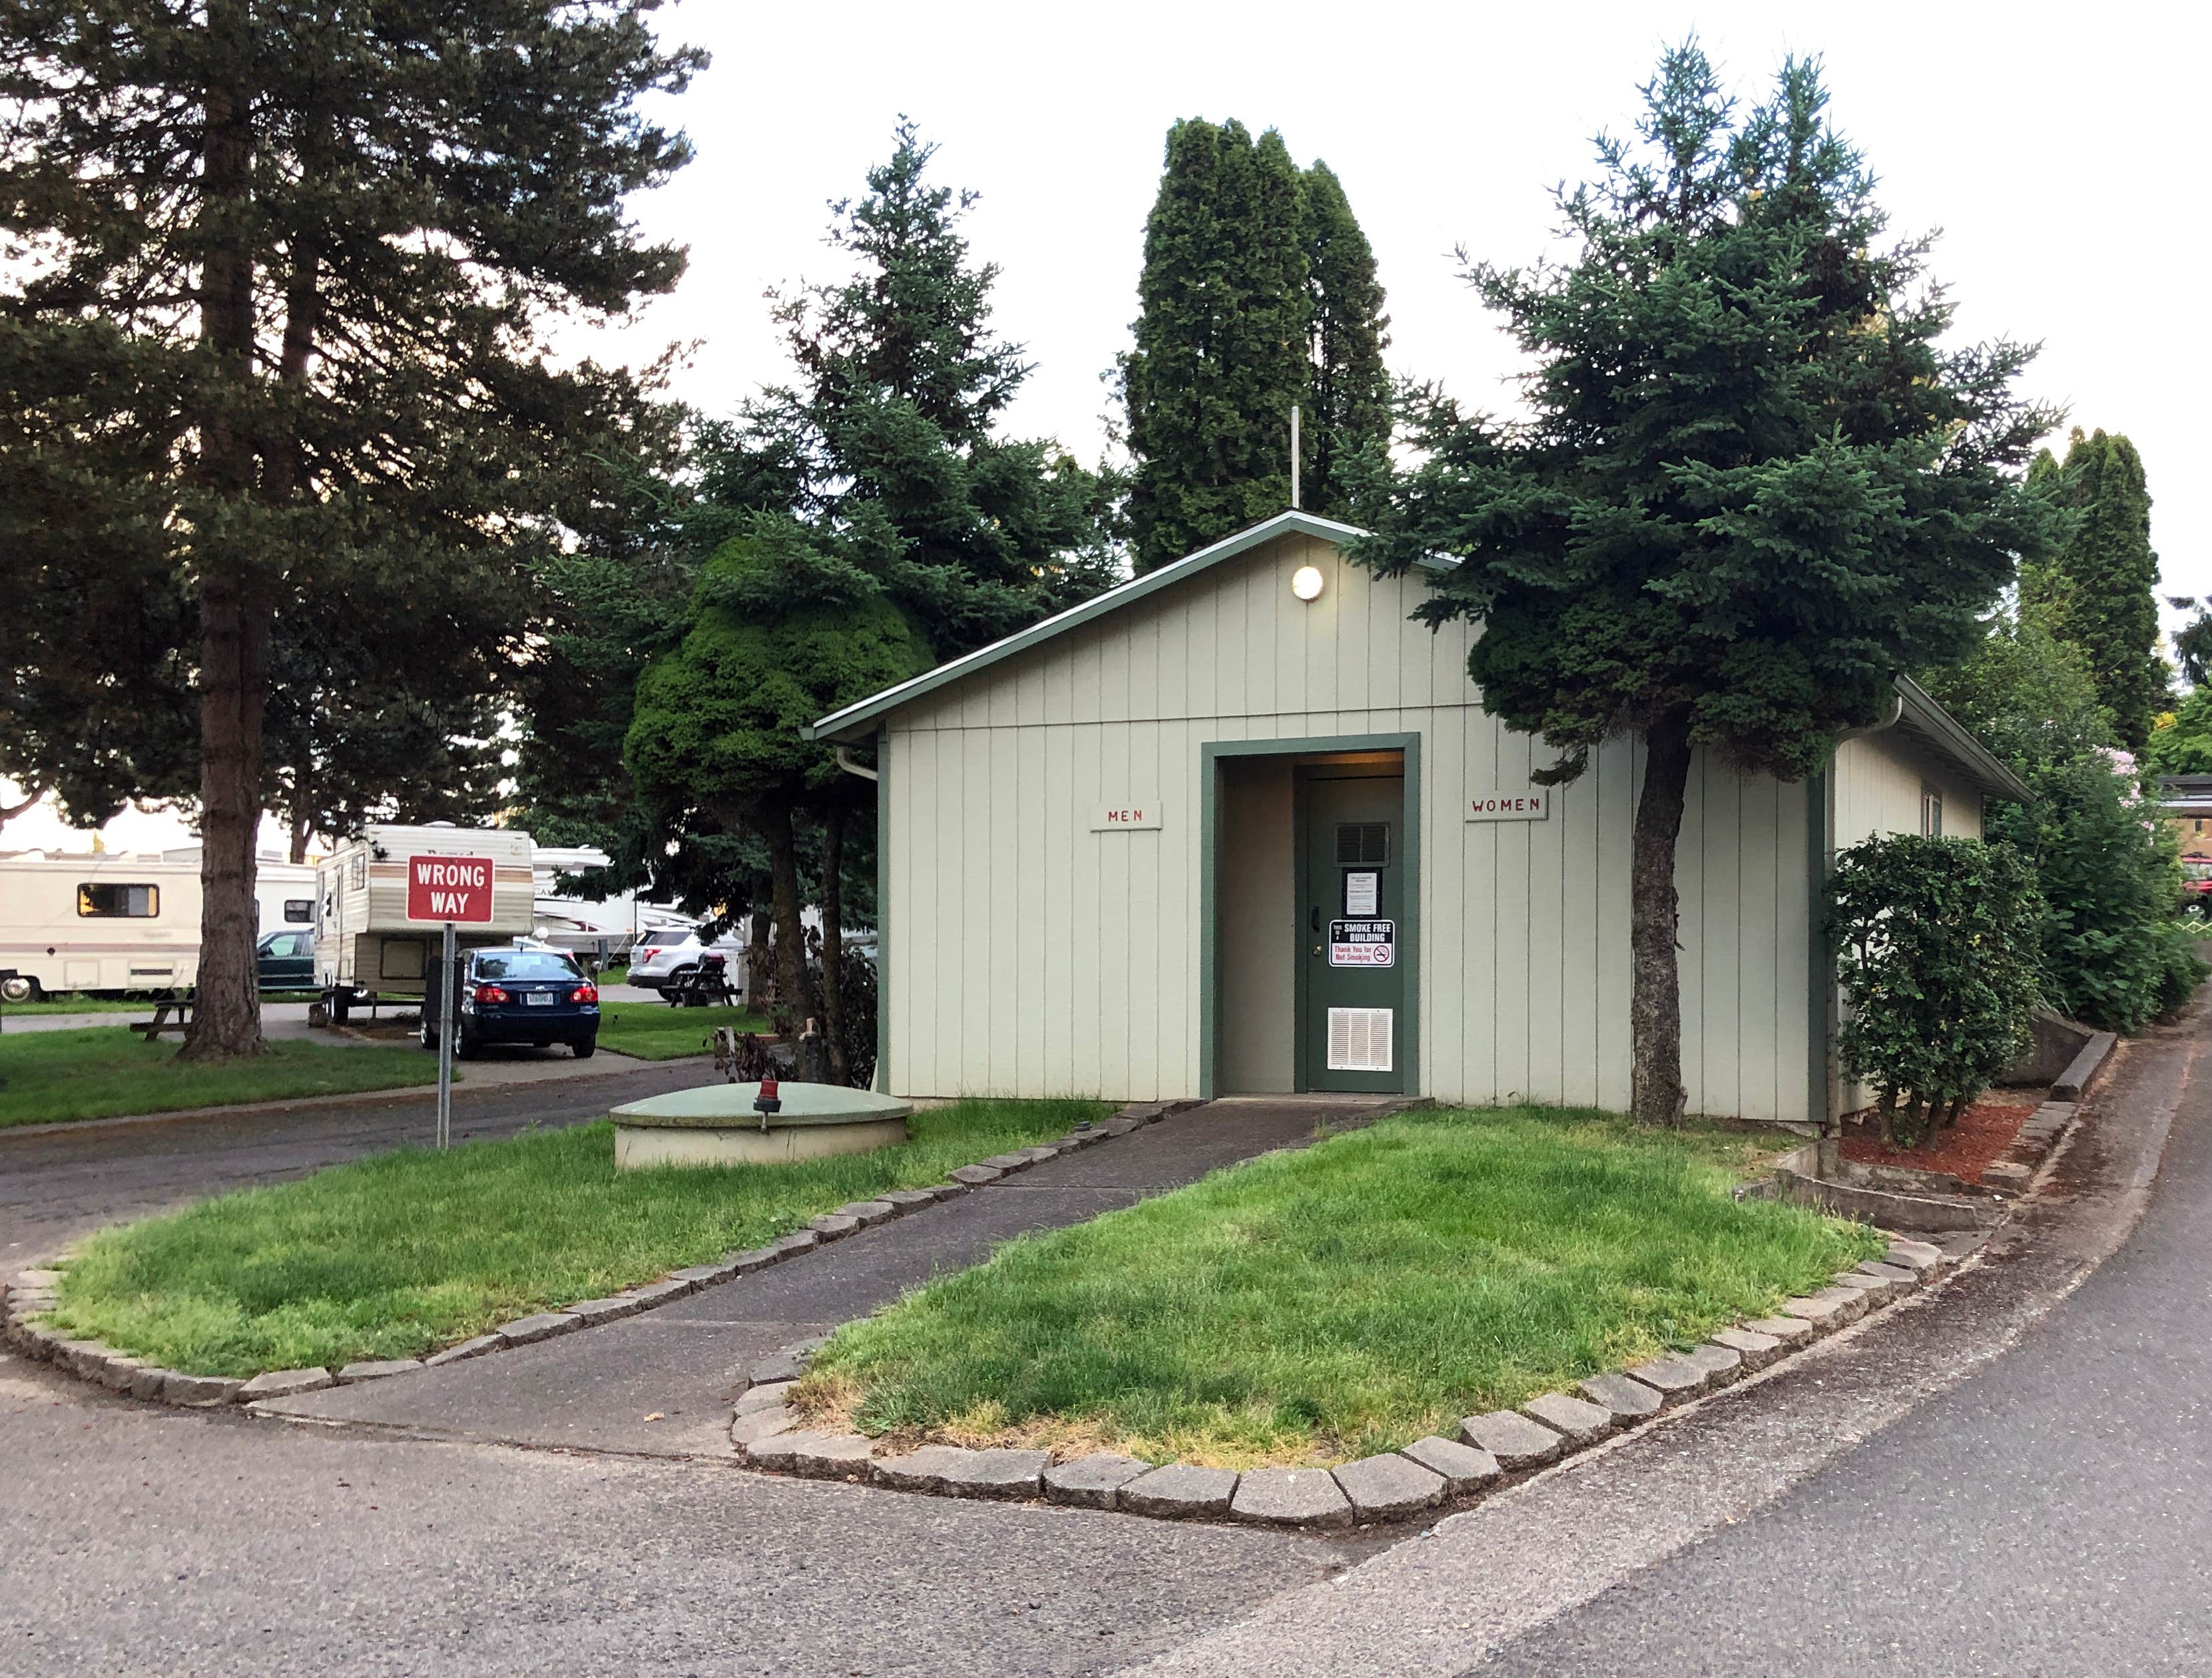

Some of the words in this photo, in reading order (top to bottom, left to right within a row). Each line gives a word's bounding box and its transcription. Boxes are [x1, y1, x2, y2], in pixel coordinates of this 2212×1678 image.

[1472, 798, 1539, 812] WOMEN
[1107, 810, 1143, 822] MEN
[416, 863, 485, 888] WRONG
[430, 892, 469, 914] WAY
[1344, 924, 1372, 933] SMOKE
[1373, 924, 1391, 933] FREE
[1350, 933, 1386, 942] BUILDING
[1346, 954, 1371, 962] Smoking
